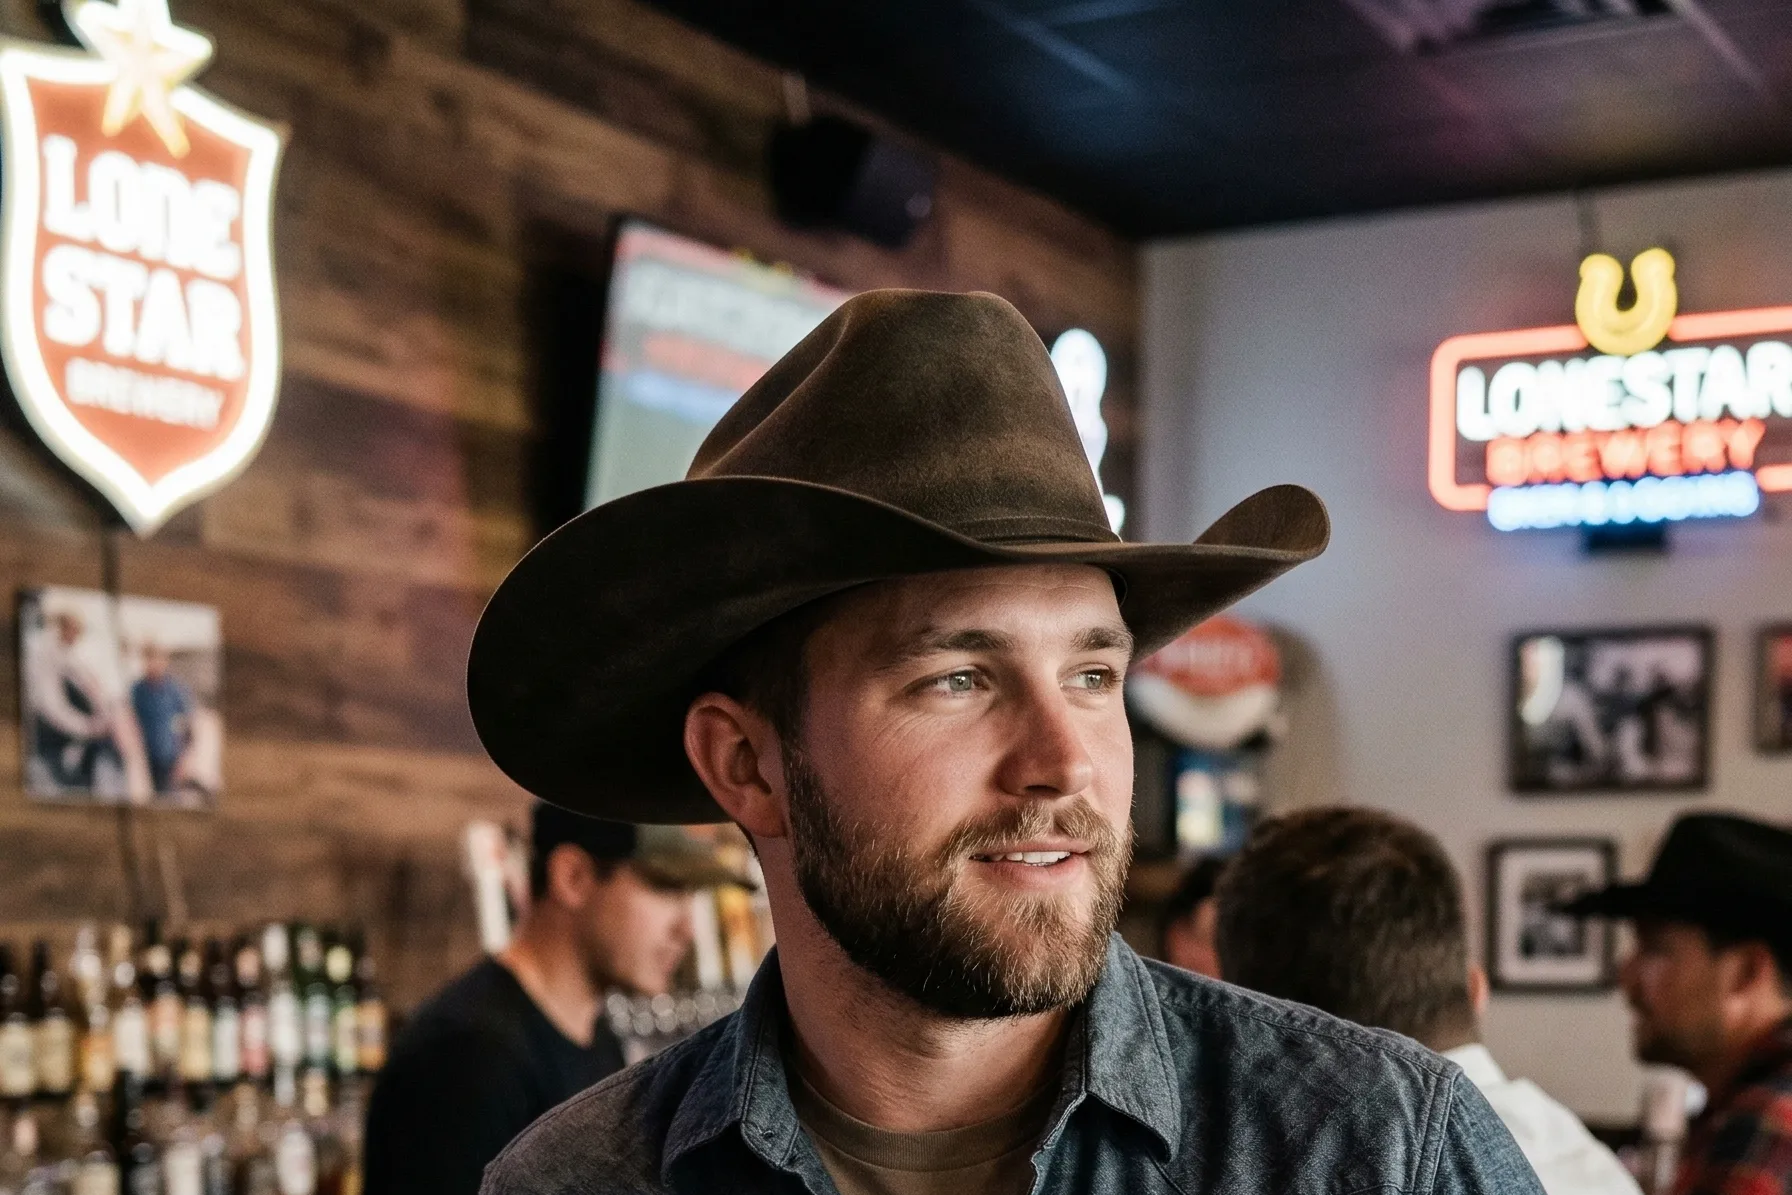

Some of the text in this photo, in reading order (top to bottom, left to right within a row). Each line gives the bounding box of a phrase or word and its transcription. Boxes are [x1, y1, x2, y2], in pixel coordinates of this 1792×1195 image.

[43, 134, 241, 279] LONE
[44, 244, 244, 380] STAR
[1456, 341, 1792, 441] LONESTAR
